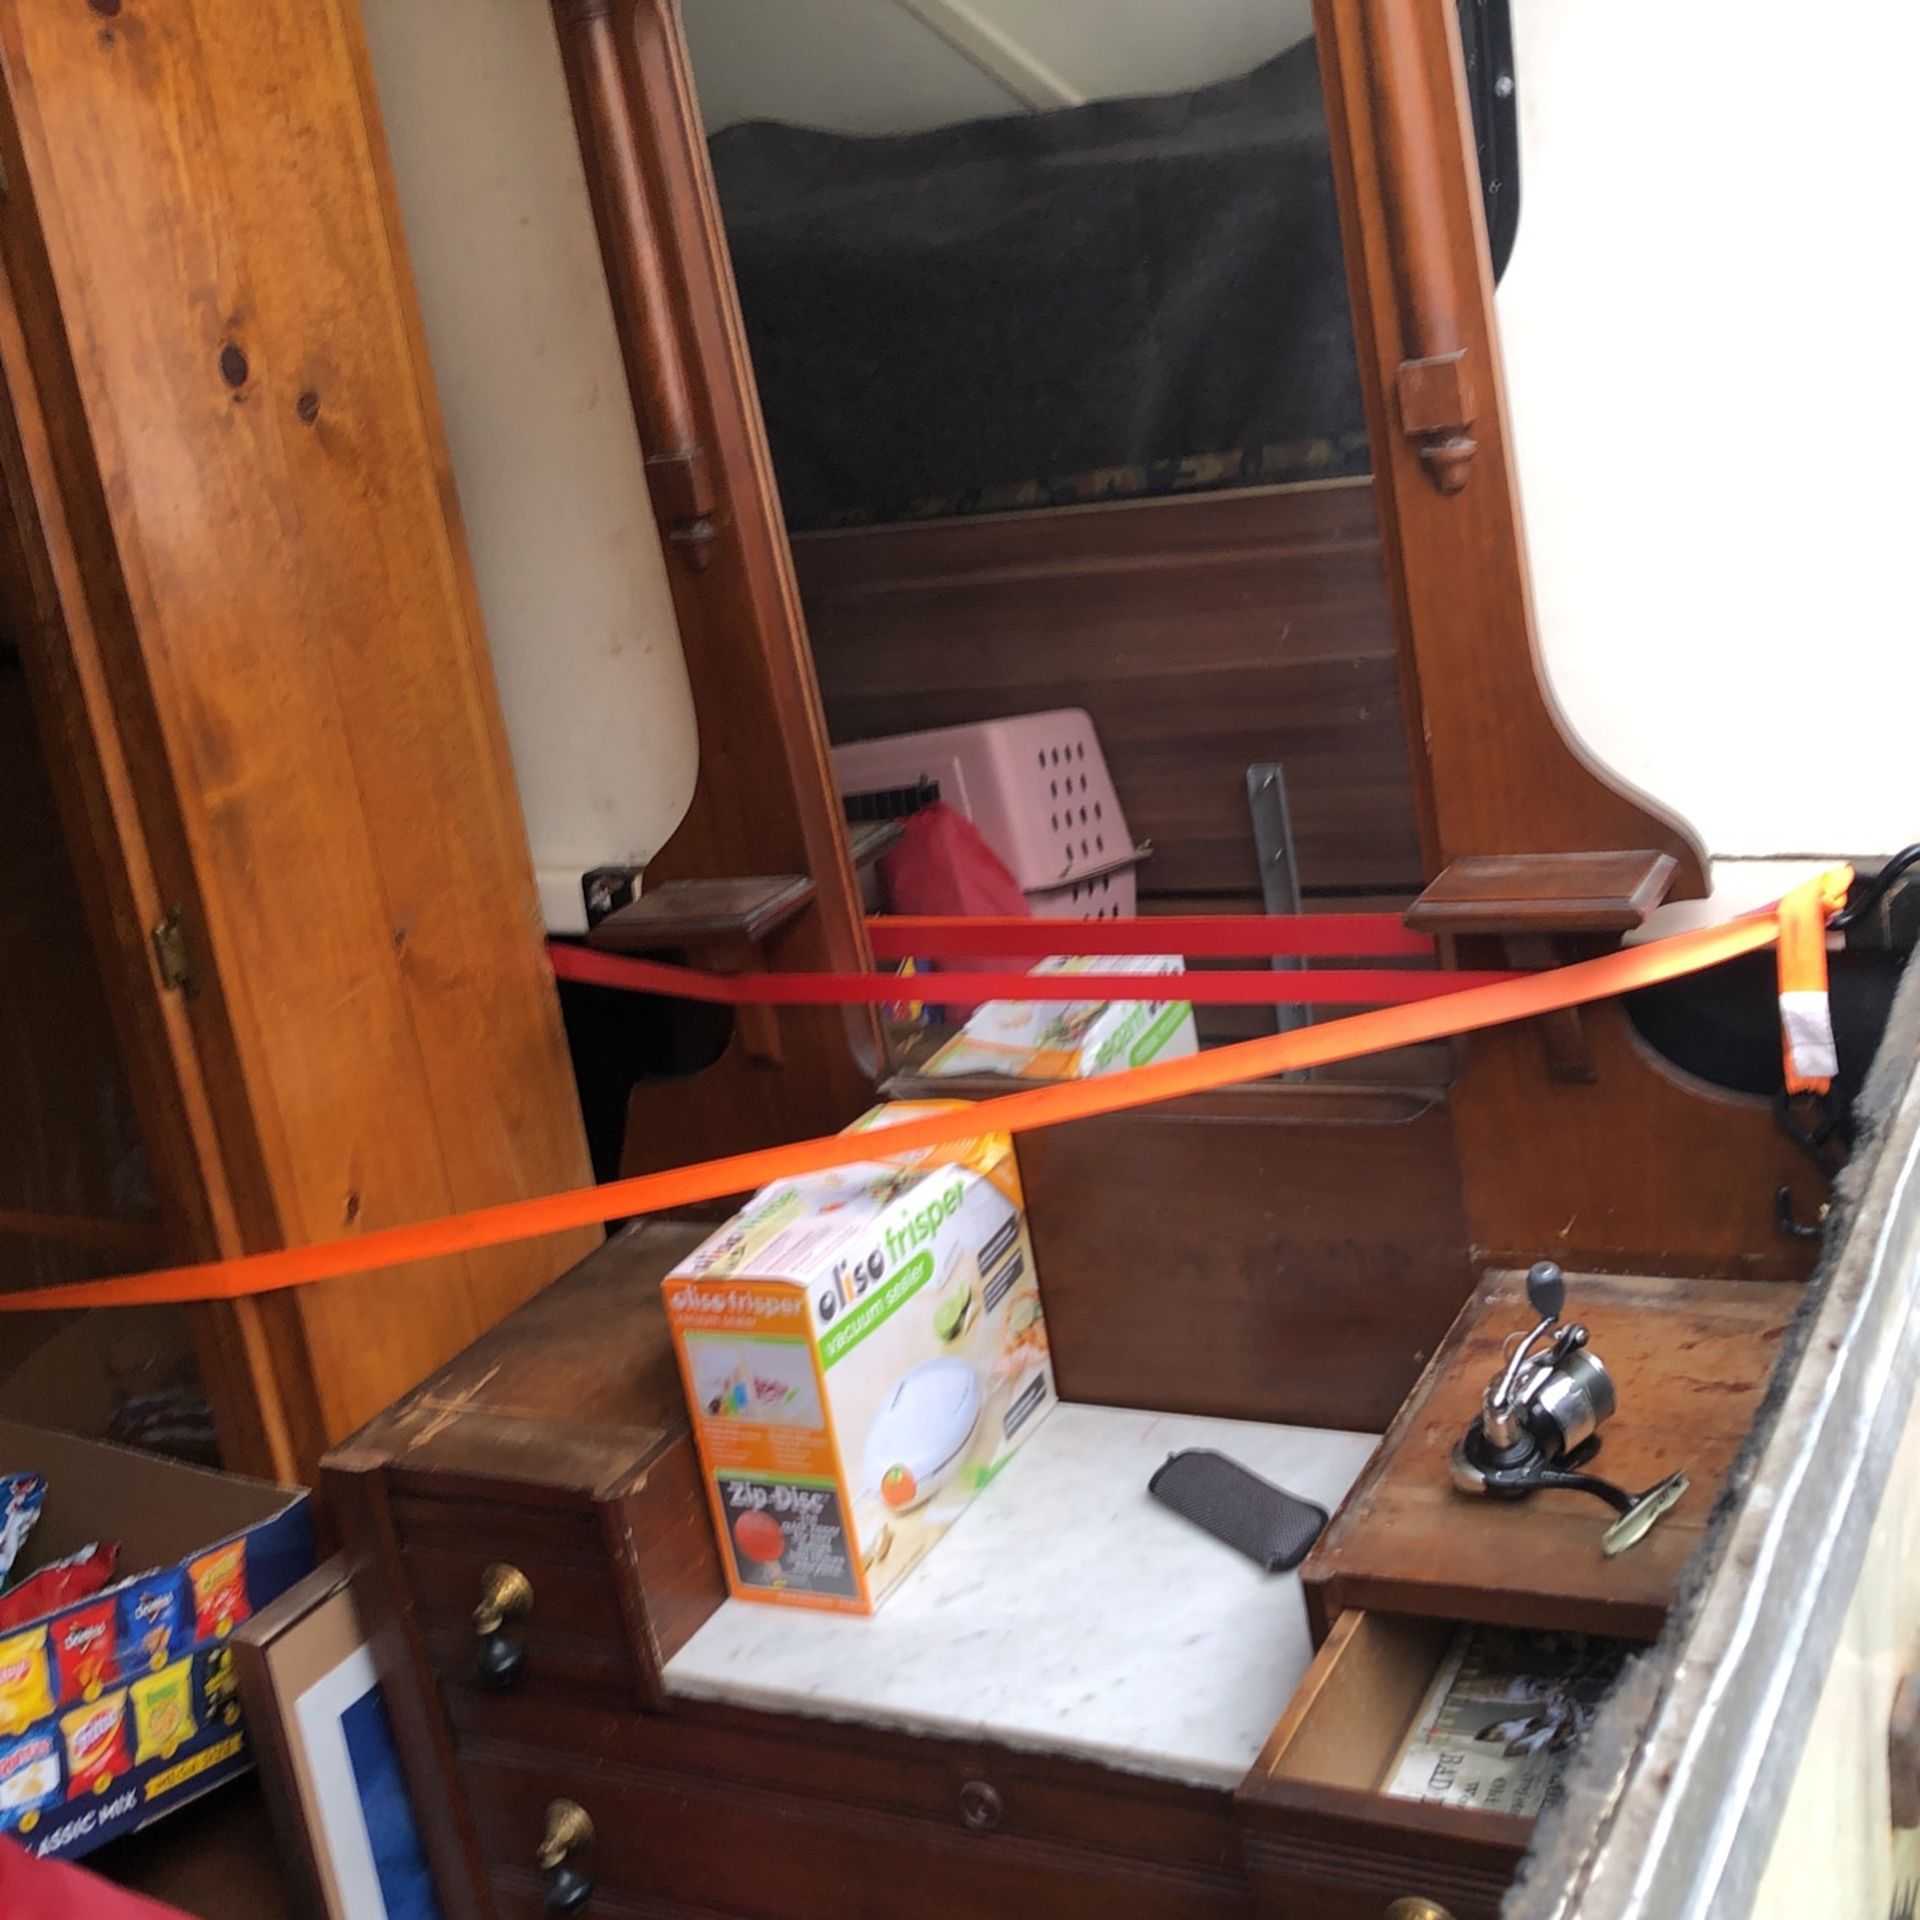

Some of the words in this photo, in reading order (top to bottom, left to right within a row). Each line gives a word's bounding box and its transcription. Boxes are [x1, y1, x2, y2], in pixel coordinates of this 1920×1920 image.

[819, 1248, 885, 1322] oliso
[885, 1179, 965, 1265] frisper
[825, 1299, 884, 1355] vacuum
[886, 1261, 925, 1304] sealer
